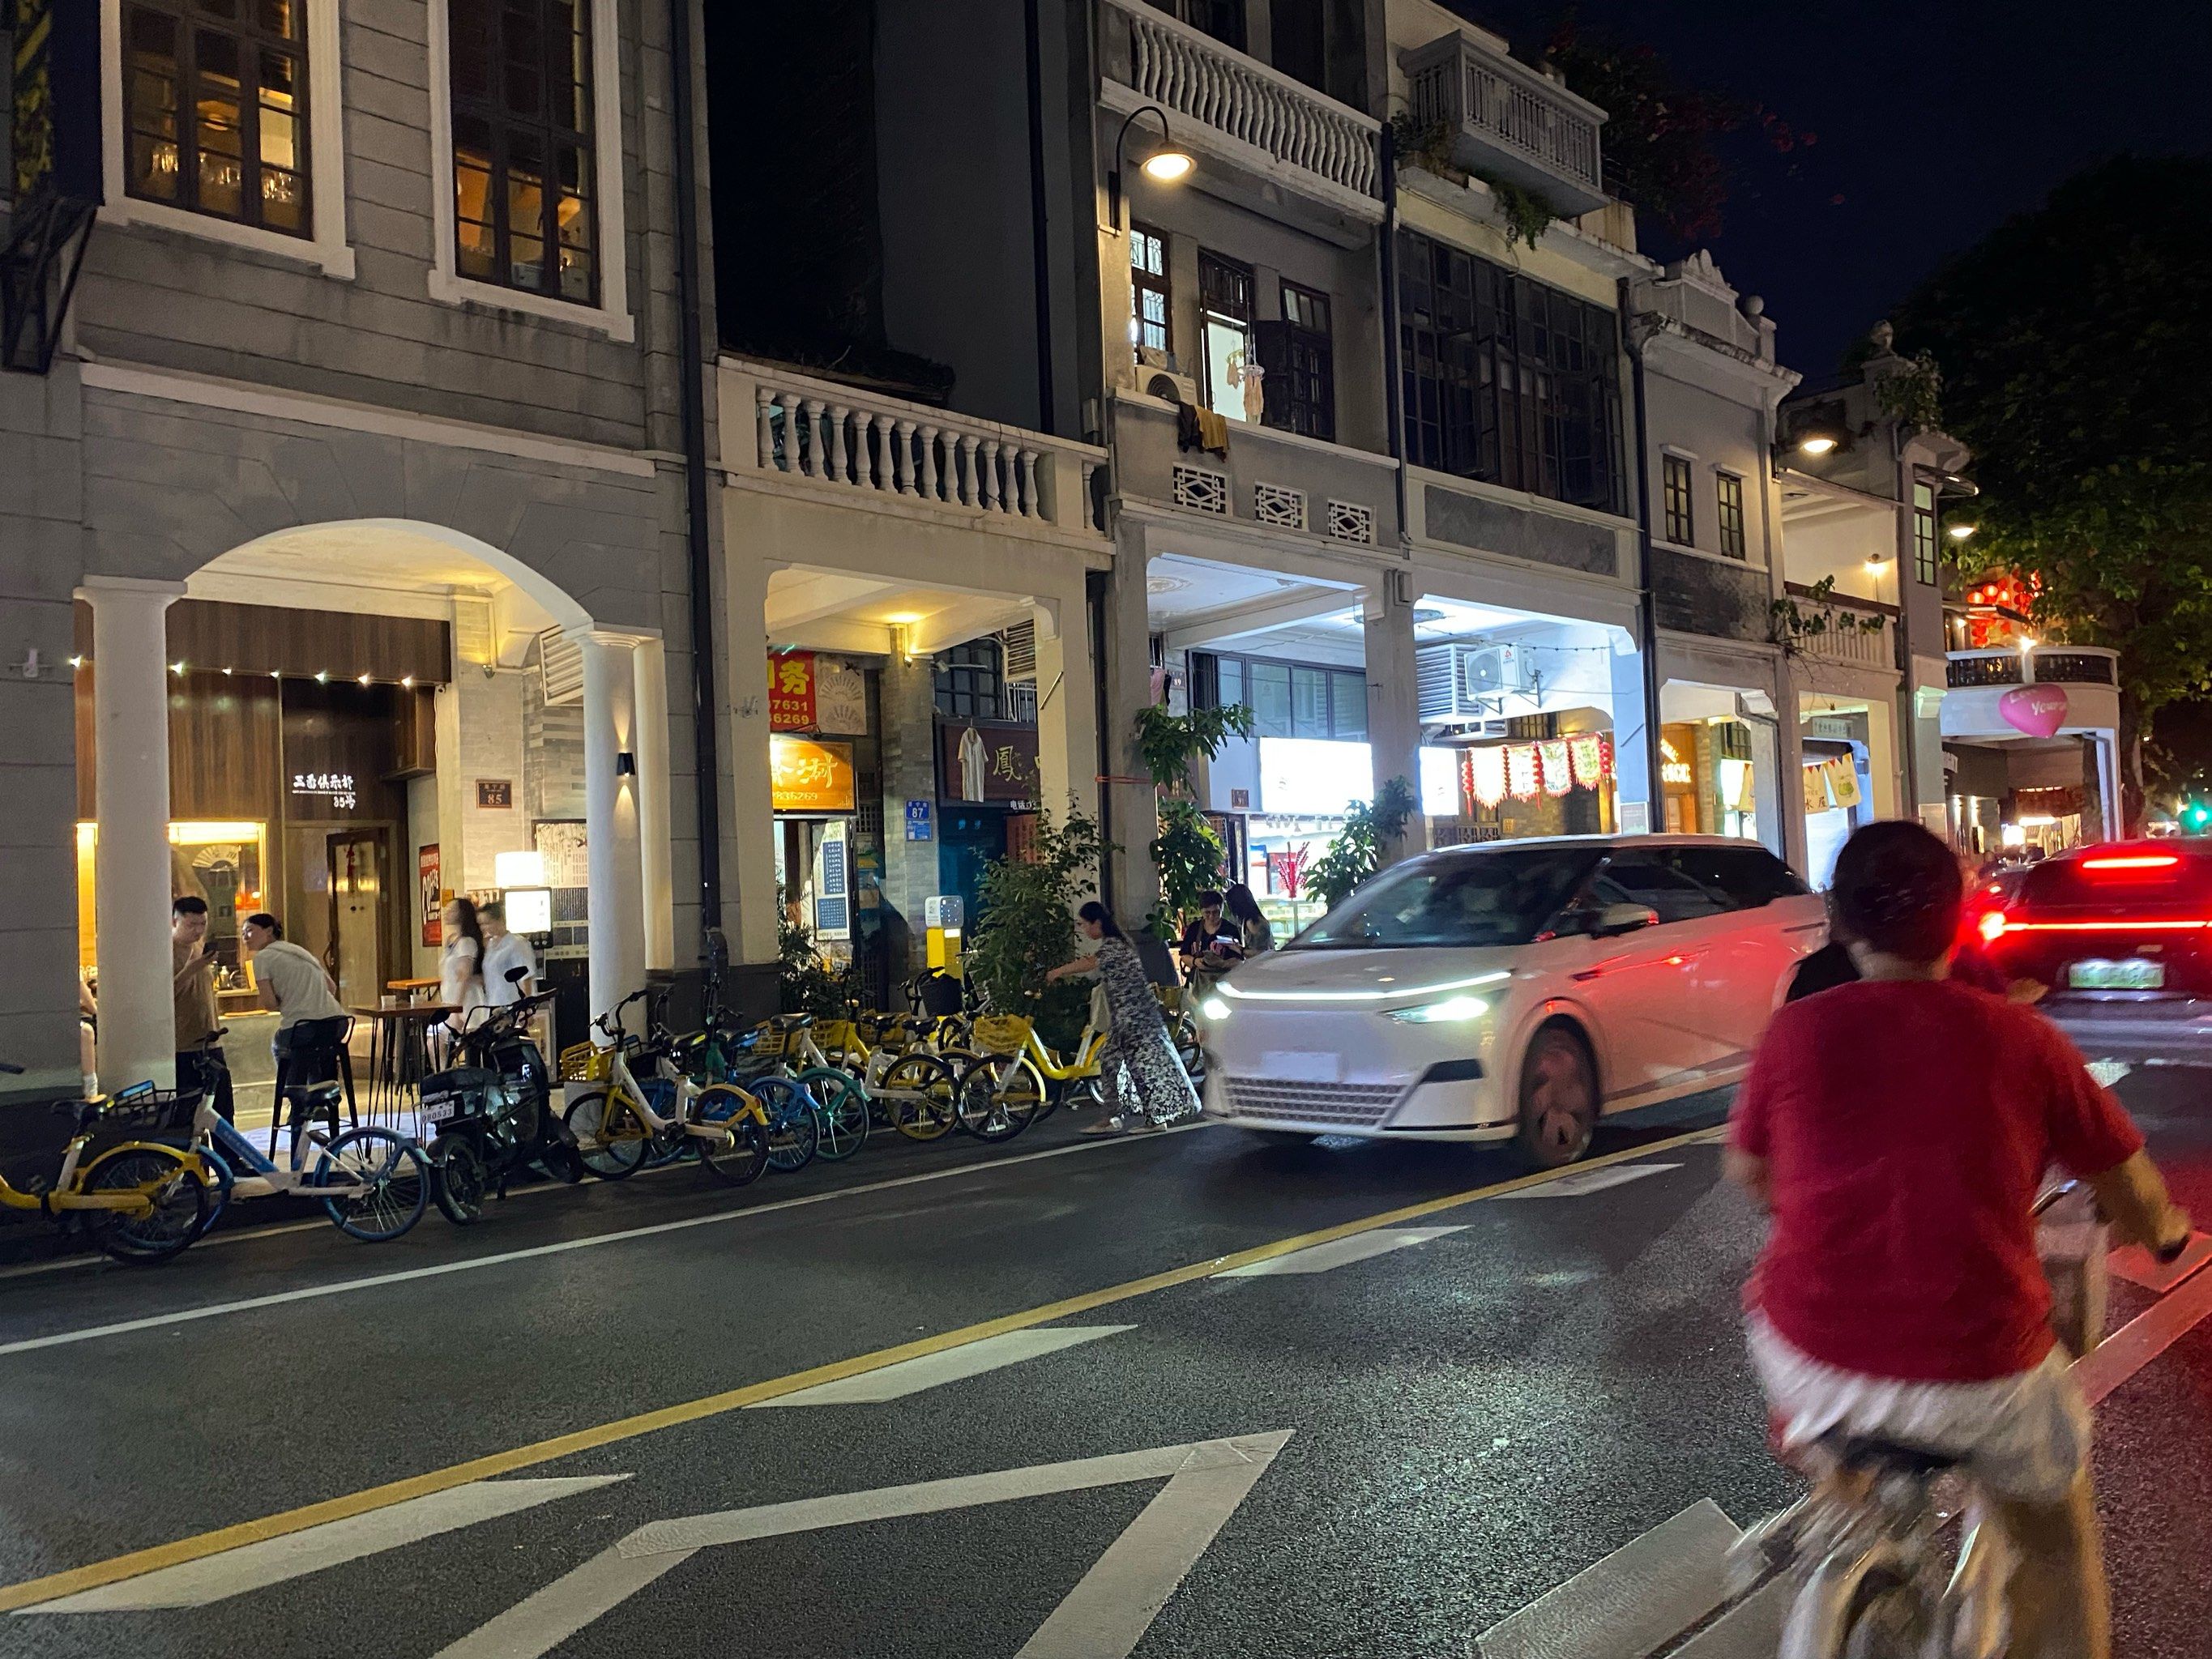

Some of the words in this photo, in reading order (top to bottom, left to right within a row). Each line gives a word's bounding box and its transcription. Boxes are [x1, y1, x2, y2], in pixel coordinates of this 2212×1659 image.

[767, 659, 809, 695] 务
[488, 794, 502, 804] 85
[912, 807, 924, 818] 87
